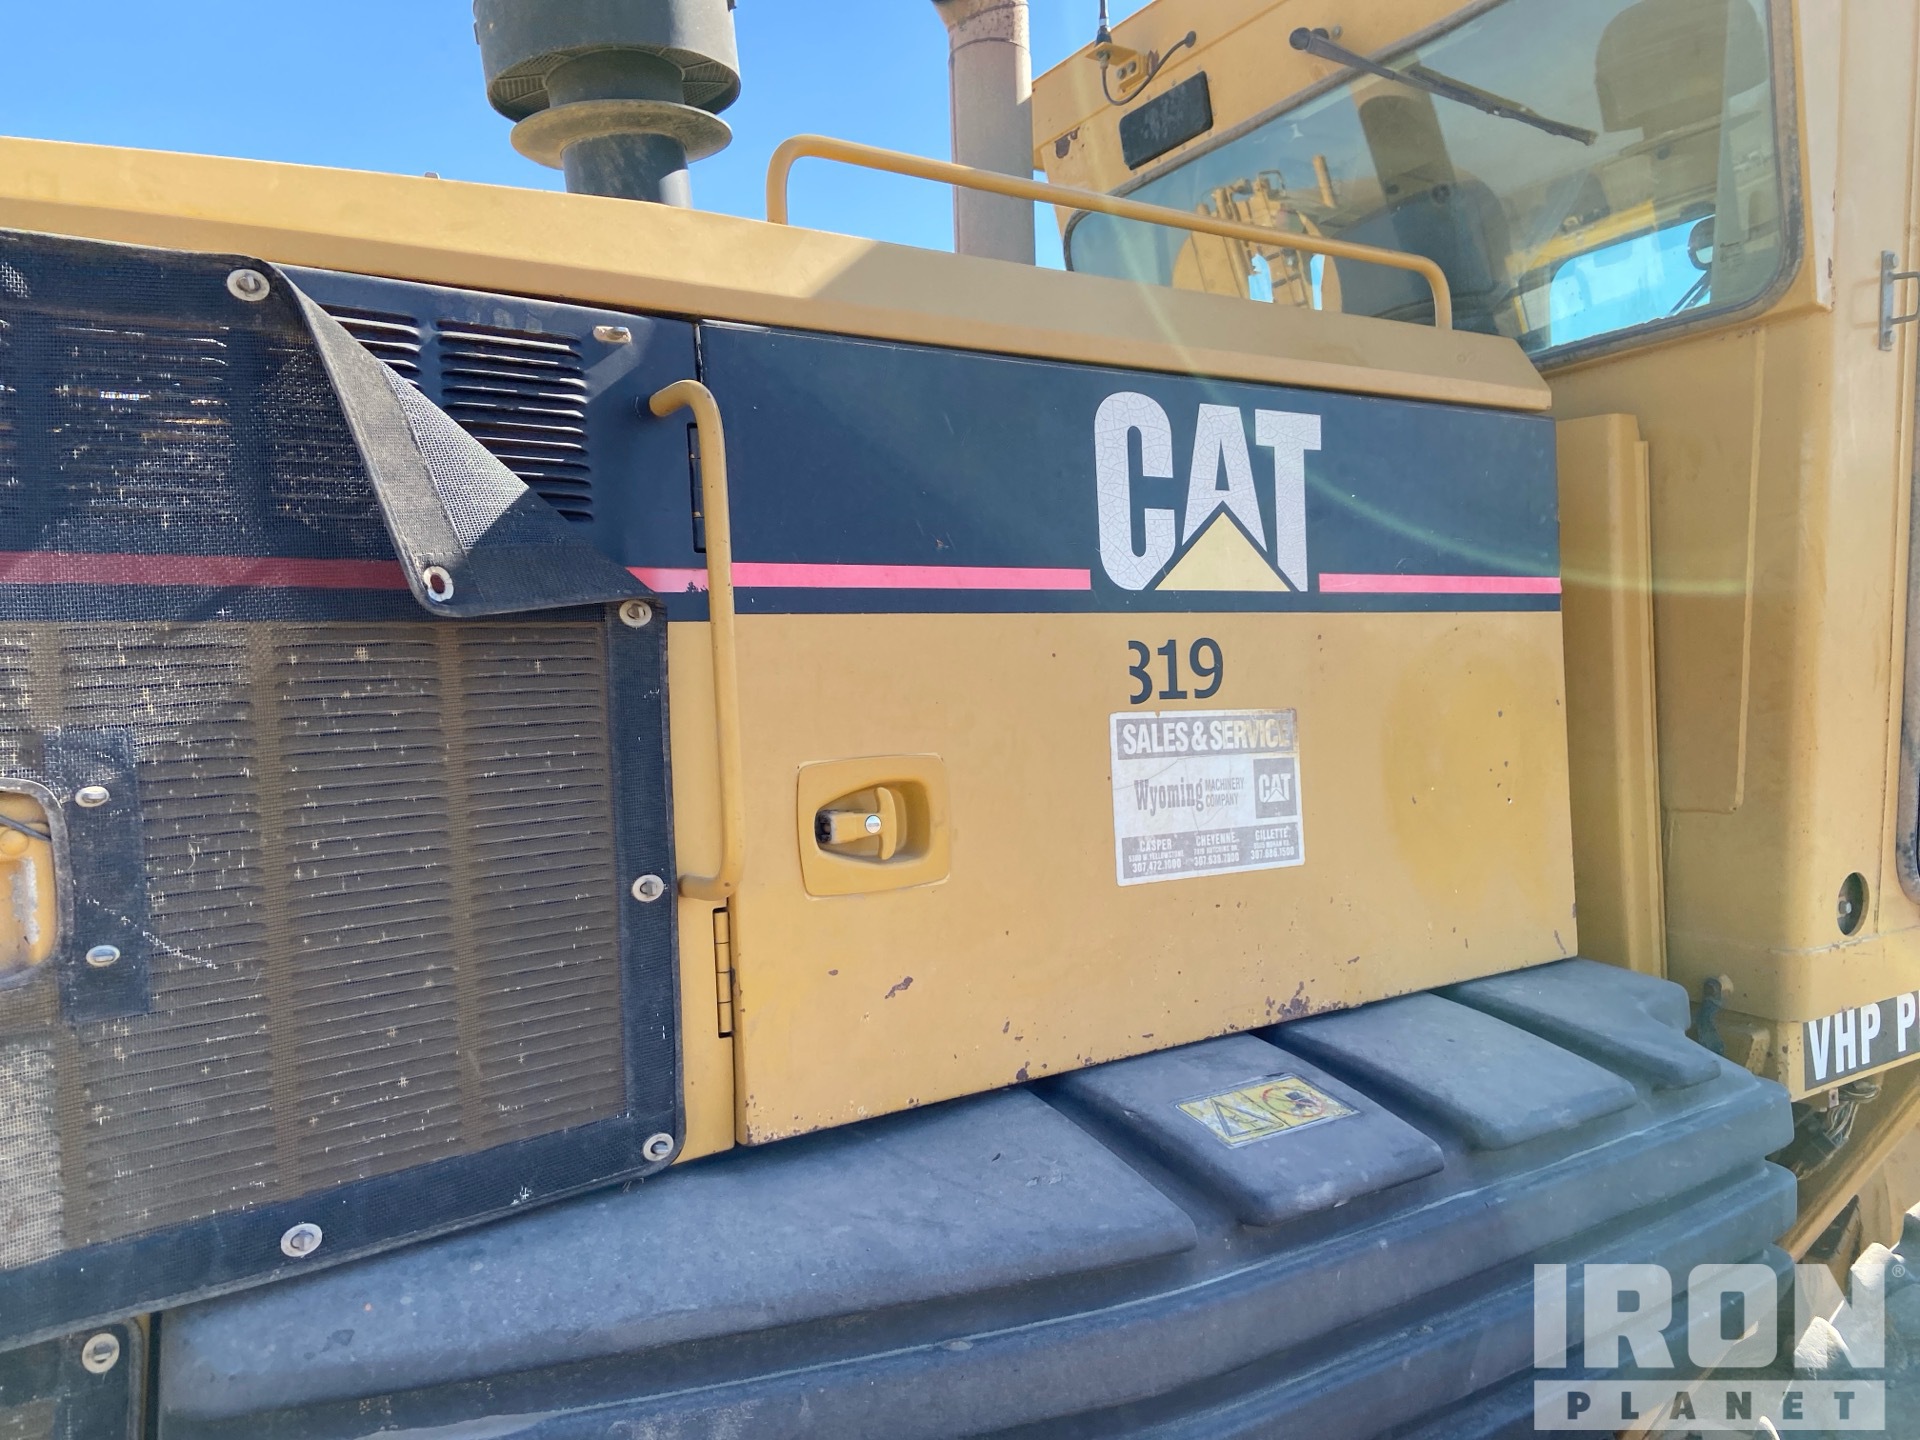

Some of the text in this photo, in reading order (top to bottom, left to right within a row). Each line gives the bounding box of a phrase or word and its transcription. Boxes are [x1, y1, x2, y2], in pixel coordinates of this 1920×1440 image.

[1094, 391, 1322, 592] CAT
[1128, 637, 1224, 705] 319
[1204, 777, 1245, 792] MACHINERY
[1259, 773, 1292, 803] CAT
[1134, 777, 1205, 816] Wyoming
[1205, 793, 1239, 808] COMPANY
[1139, 838, 1172, 852] CASPER
[1196, 832, 1236, 847] CHEYENNE
[1255, 828, 1289, 841] GILLETTE
[1808, 992, 1920, 1081] VHP P
